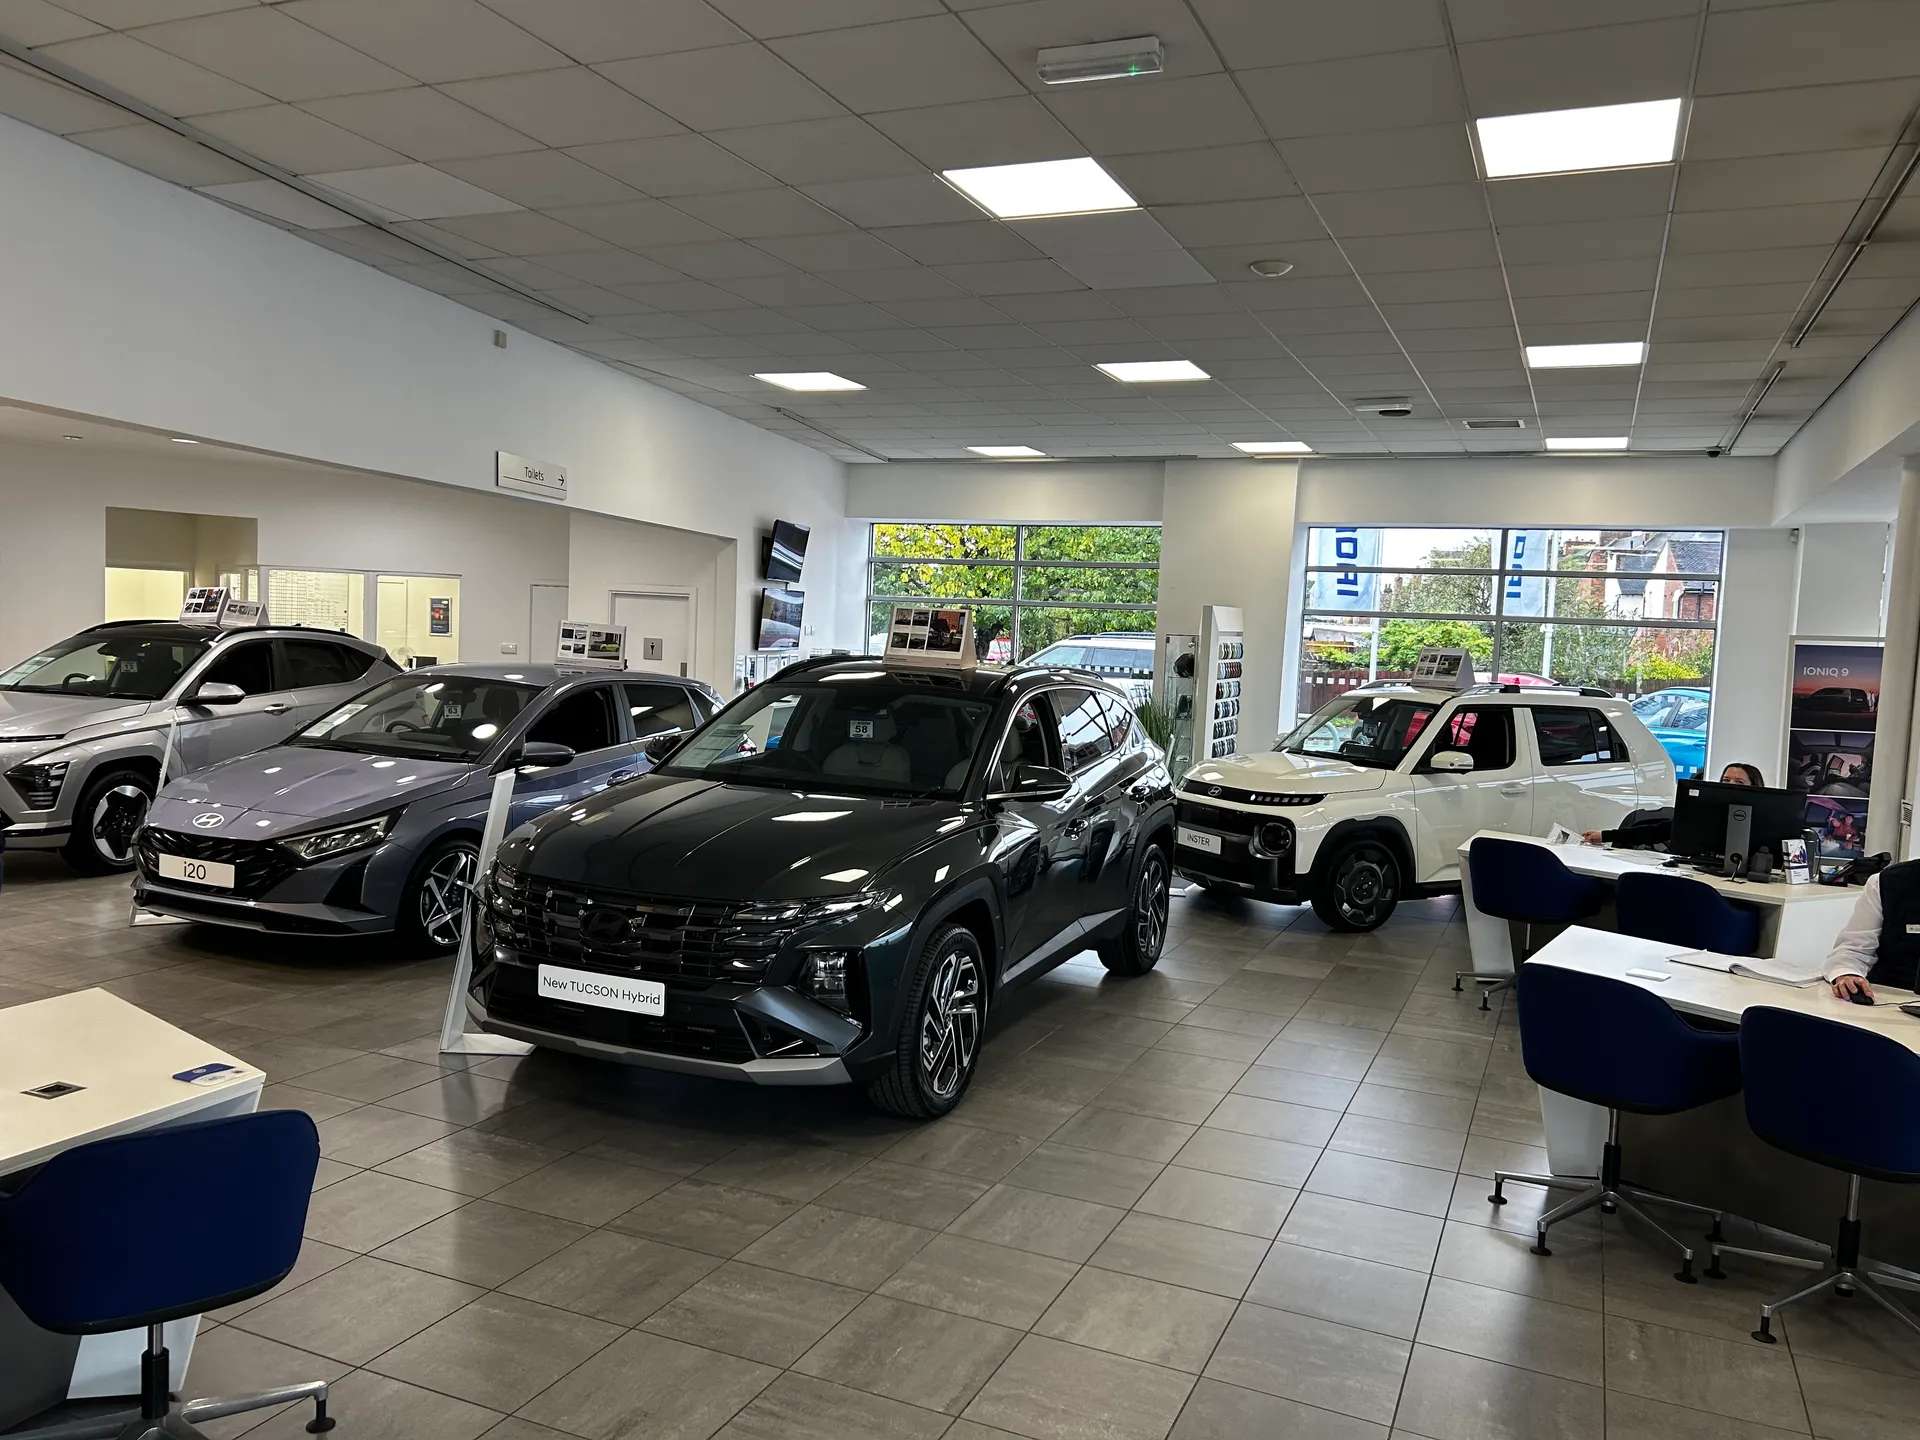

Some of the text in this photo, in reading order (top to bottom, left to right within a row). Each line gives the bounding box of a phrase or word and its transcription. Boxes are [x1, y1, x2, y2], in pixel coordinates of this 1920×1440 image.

[523, 466, 545, 481] Toilets
[1802, 666, 1849, 678] IONIQ 9
[855, 725, 868, 733] 58
[1187, 833, 1210, 846] INSTER
[183, 861, 206, 880] i20
[543, 976, 661, 1005] New TUCSON Hybrid
